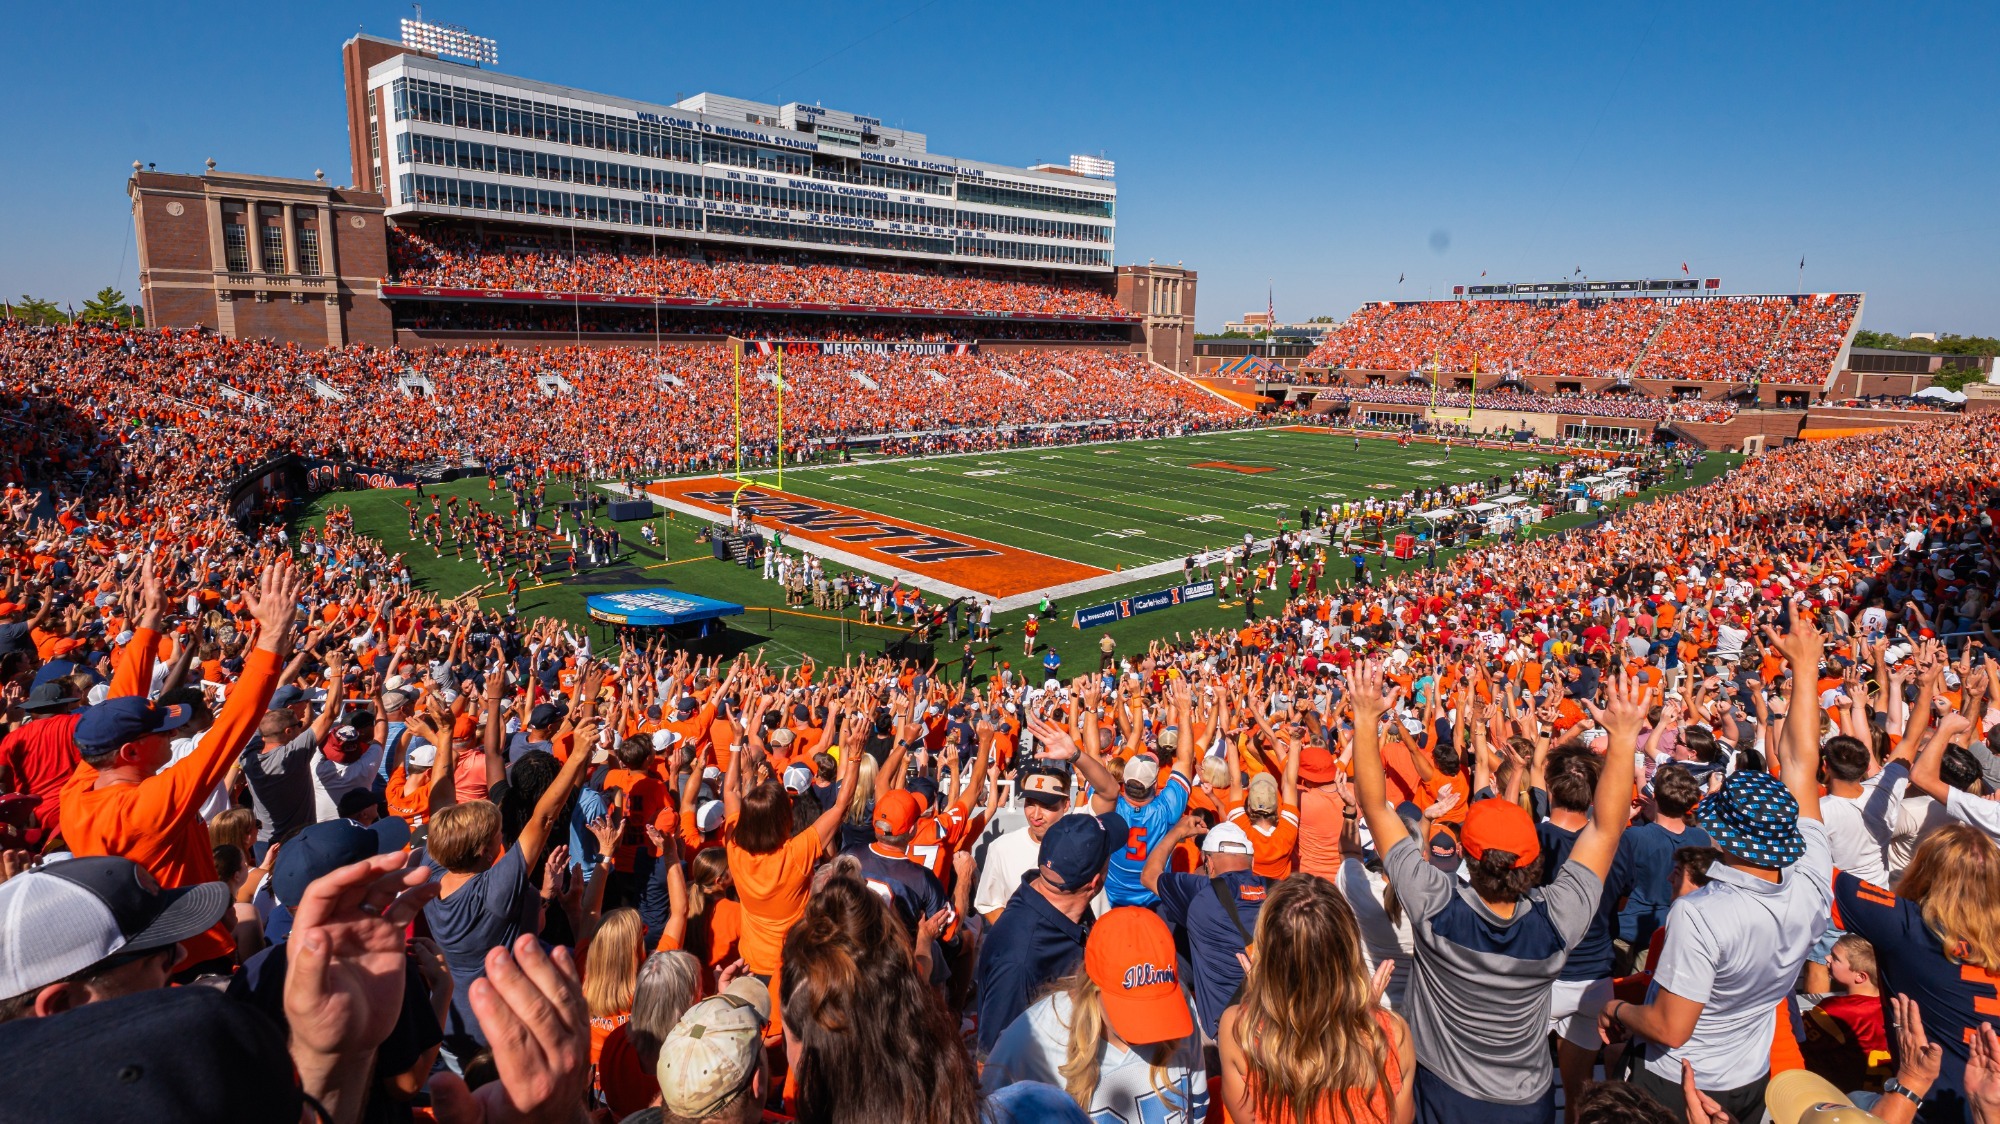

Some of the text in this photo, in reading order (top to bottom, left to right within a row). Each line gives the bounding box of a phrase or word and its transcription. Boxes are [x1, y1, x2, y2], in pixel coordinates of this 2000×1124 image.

[796, 104, 826, 116] GRANGE
[807, 114, 815, 124] 77
[854, 115, 880, 126] BUTKUS
[636, 111, 818, 152] WELCOME TO MEMORIAL STADIUM
[862, 125, 872, 134] 50
[860, 151, 984, 177] HOME OF THE FIGHTING ILLINI
[788, 180, 888, 200] NATIONAL CHAMPIONS
[644, 194, 658, 202] 190
[824, 214, 874, 228] CHAMPIONS
[422, 288, 440, 296] Carle
[486, 290, 504, 298] Carle
[787, 342, 946, 355] GIES MEMORIAL STADIUM
[306, 464, 398, 492] Illnois
[1185, 583, 1214, 596] GRAINGER
[1087, 612, 1105, 620] Invesco
[1160, 676, 1164, 684] 9
[1034, 778, 1044, 789] I
[1126, 826, 1148, 862] 5
[1122, 962, 1176, 990] Illinoi
